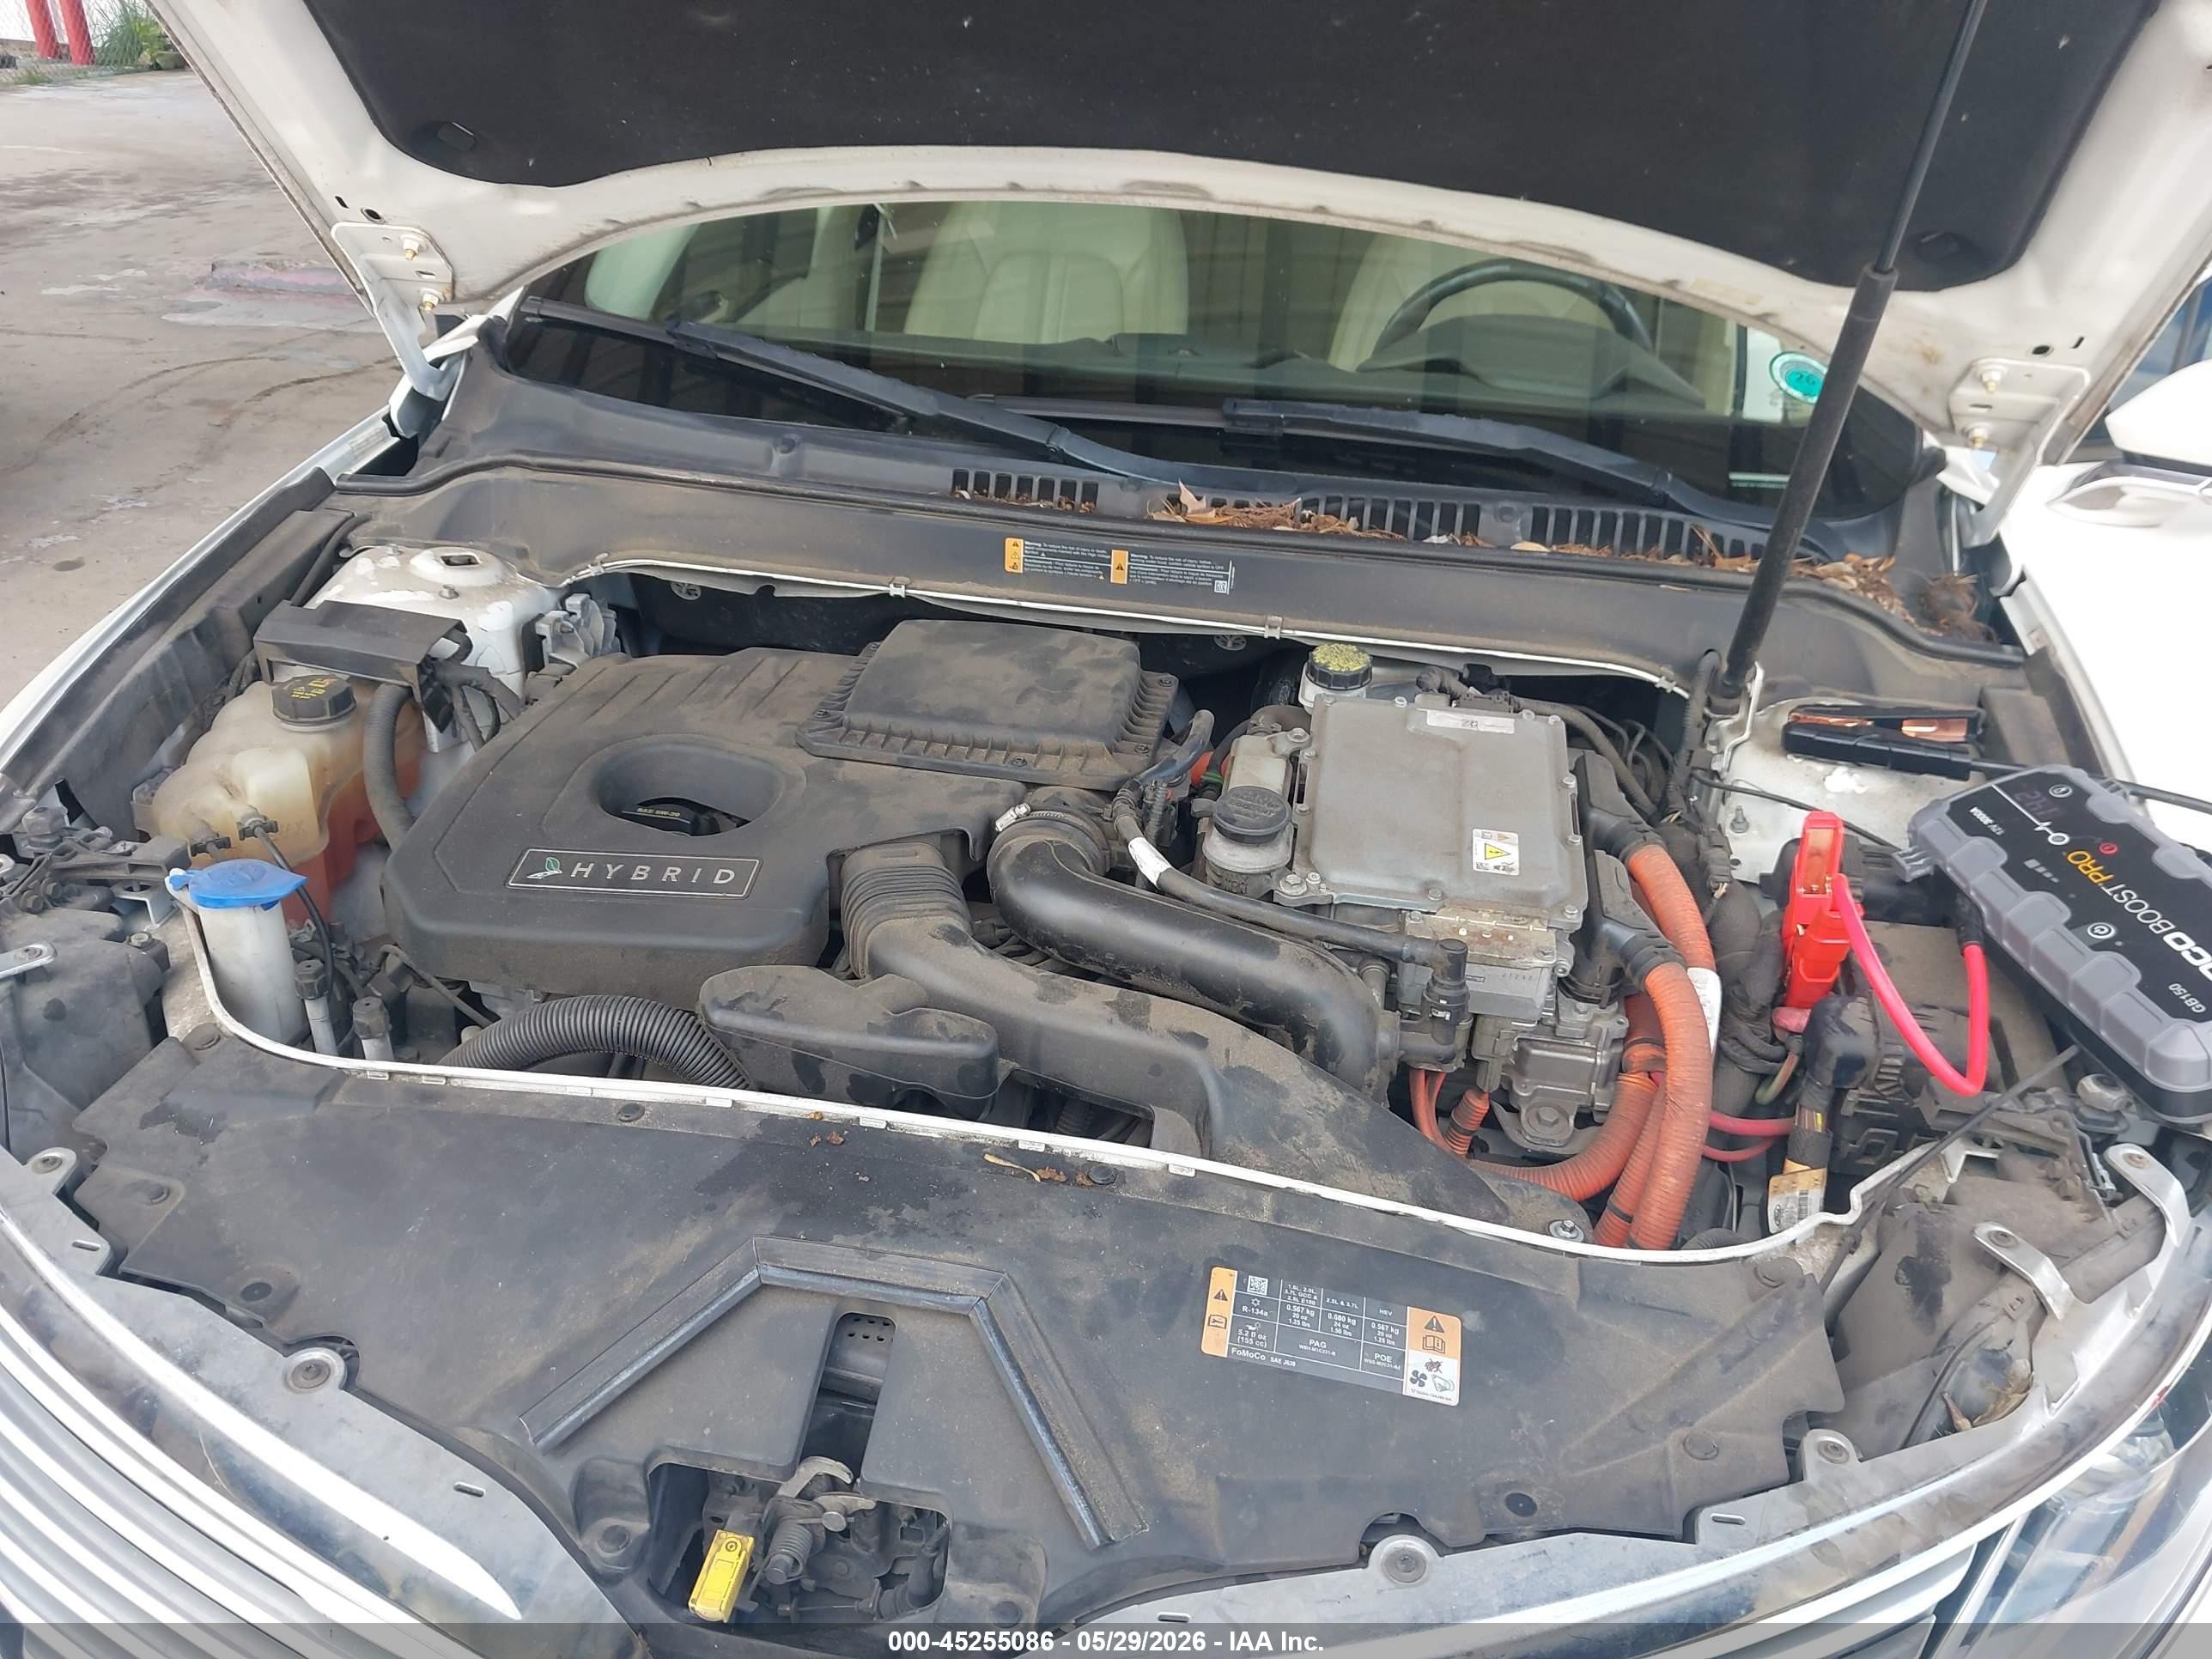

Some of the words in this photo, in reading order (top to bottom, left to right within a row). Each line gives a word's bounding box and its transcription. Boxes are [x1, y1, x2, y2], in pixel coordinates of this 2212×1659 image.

[570, 861, 736, 884] HYBRID
[2067, 850, 2114, 884] PRO
[2101, 884, 2176, 934] BOOST
[2168, 982, 2206, 1013] GB150
[1242, 1305, 1268, 1316] R-134a
[1306, 1308, 1316, 1317] kg
[1347, 1316, 1357, 1326] kg
[1390, 1326, 1400, 1335] kg
[1237, 1336, 1254, 1345] (155
[1255, 1340, 1267, 1348] cc)
[1310, 1339, 1327, 1349] PAG
[1231, 1347, 1267, 1361] FoMoCo
[1374, 1352, 1393, 1363] POE
